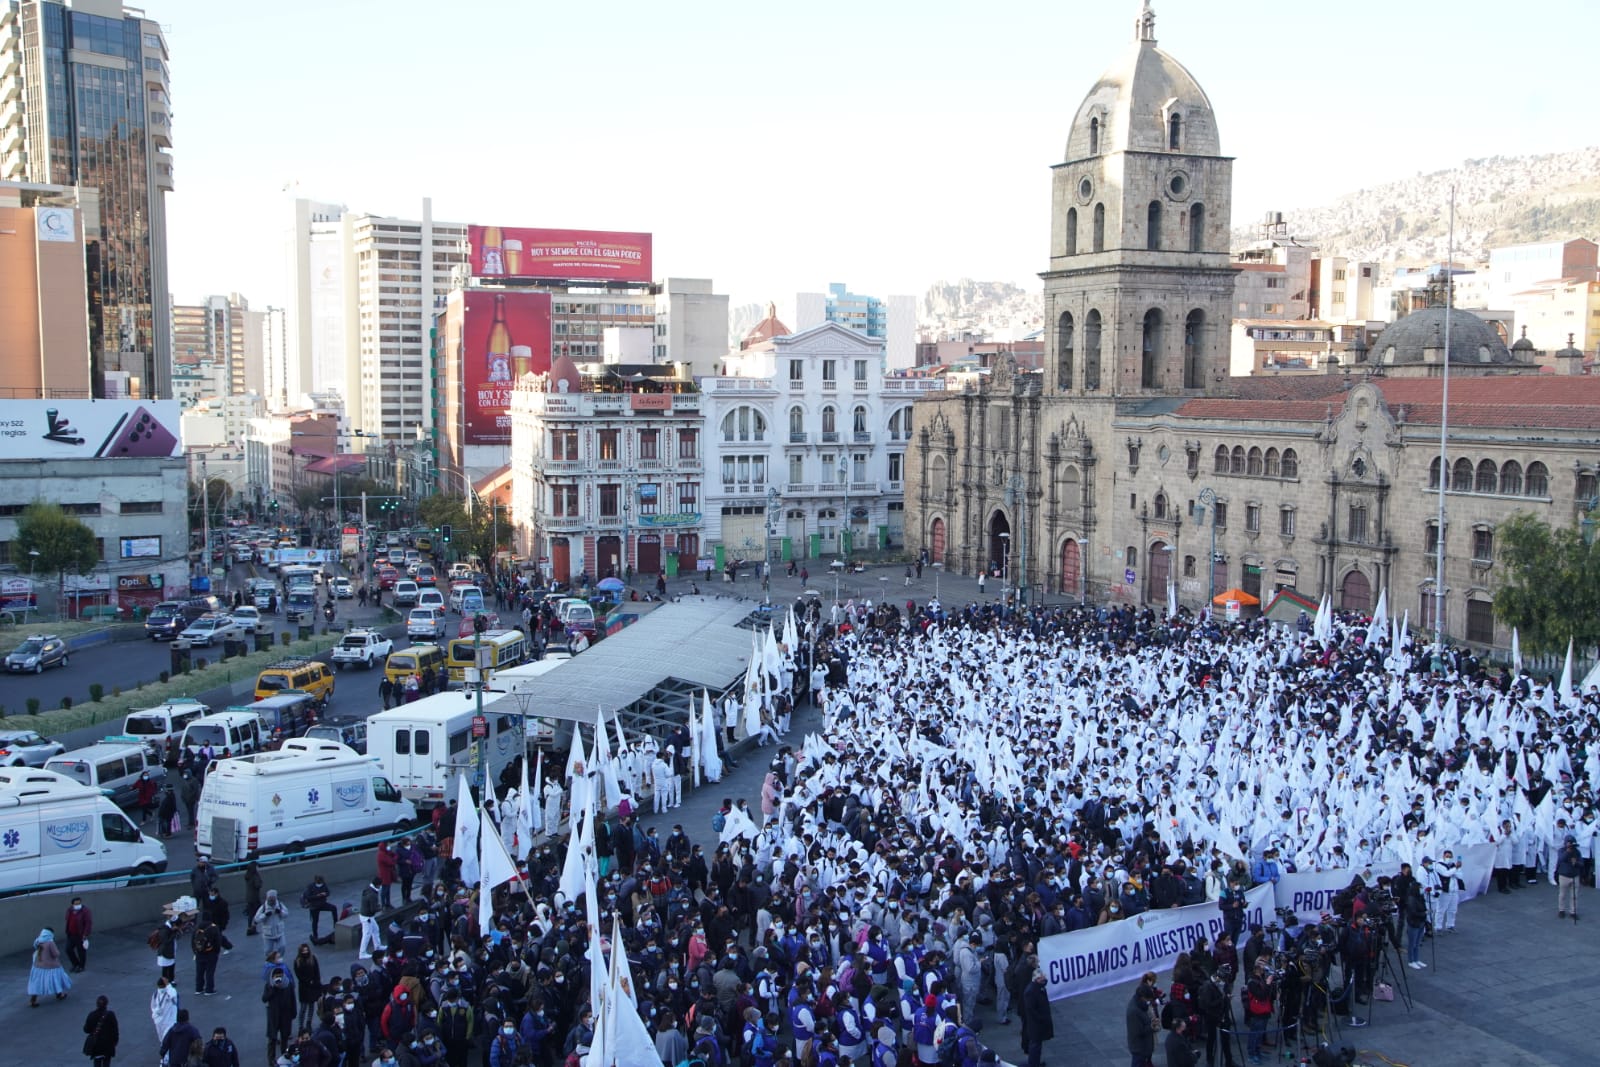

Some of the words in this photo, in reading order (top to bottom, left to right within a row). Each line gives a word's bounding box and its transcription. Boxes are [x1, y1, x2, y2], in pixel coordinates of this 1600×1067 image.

[531, 247, 544, 257] HOY
[551, 247, 579, 256] SIEMPRE
[580, 247, 593, 256] CON
[594, 248, 602, 256] EL
[603, 248, 620, 258] GRAN
[621, 250, 642, 260] PODER
[478, 390, 493, 400] HOY
[479, 399, 491, 407] CON
[1, 430, 28, 438] regias
[1293, 888, 1343, 913] PROT
[1049, 944, 1129, 985] CUIDAMOS
[1132, 941, 1141, 965] A
[1144, 922, 1206, 962] NUESTRO
